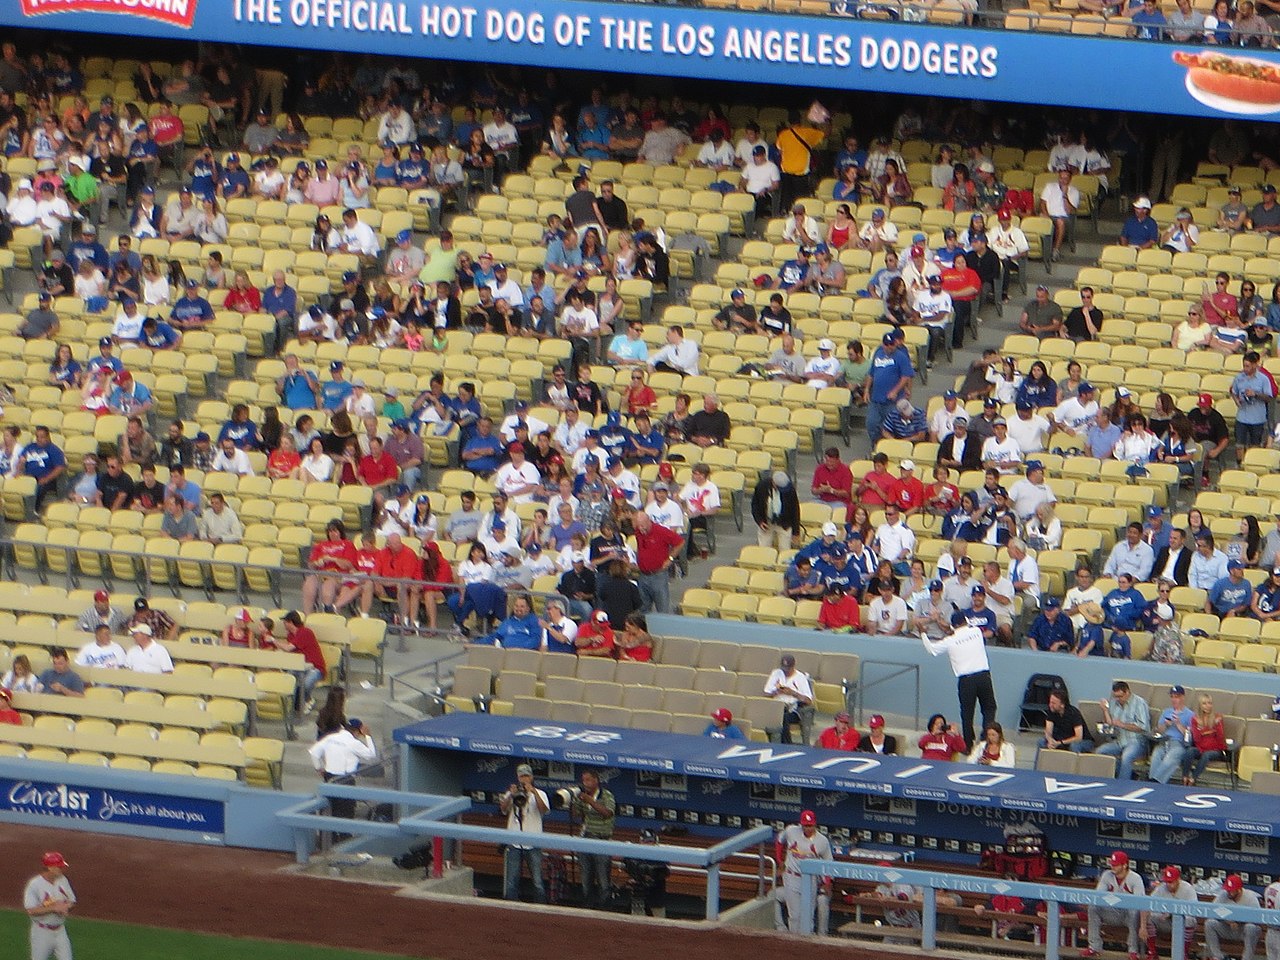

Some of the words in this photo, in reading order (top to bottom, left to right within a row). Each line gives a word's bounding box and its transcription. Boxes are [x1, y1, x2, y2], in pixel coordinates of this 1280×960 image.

[234, 0, 282, 24] THE
[290, 0, 412, 34] OFFICIAL
[421, 4, 477, 38] HOT
[486, 9, 545, 44] DOG
[554, 14, 591, 47] OF
[599, 17, 653, 52] THE
[662, 22, 715, 57] LOS
[724, 27, 852, 67] ANGELES
[861, 36, 999, 78] DODGERS
[717, 745, 1232, 809] STADIUM
[937, 802, 1002, 819] DODGER
[1009, 809, 1079, 828] STADIUM
[822, 866, 840, 876] U.S.
[844, 868, 881, 880] TRUST
[930, 878, 948, 888] U.S.
[952, 880, 988, 892] TRUST
[1039, 890, 1058, 900] U.S.
[1062, 892, 1098, 904] TRUST
[1150, 902, 1168, 912] U.S.
[1173, 904, 1210, 917] TRUST
[1261, 914, 1279, 925] U.S.
